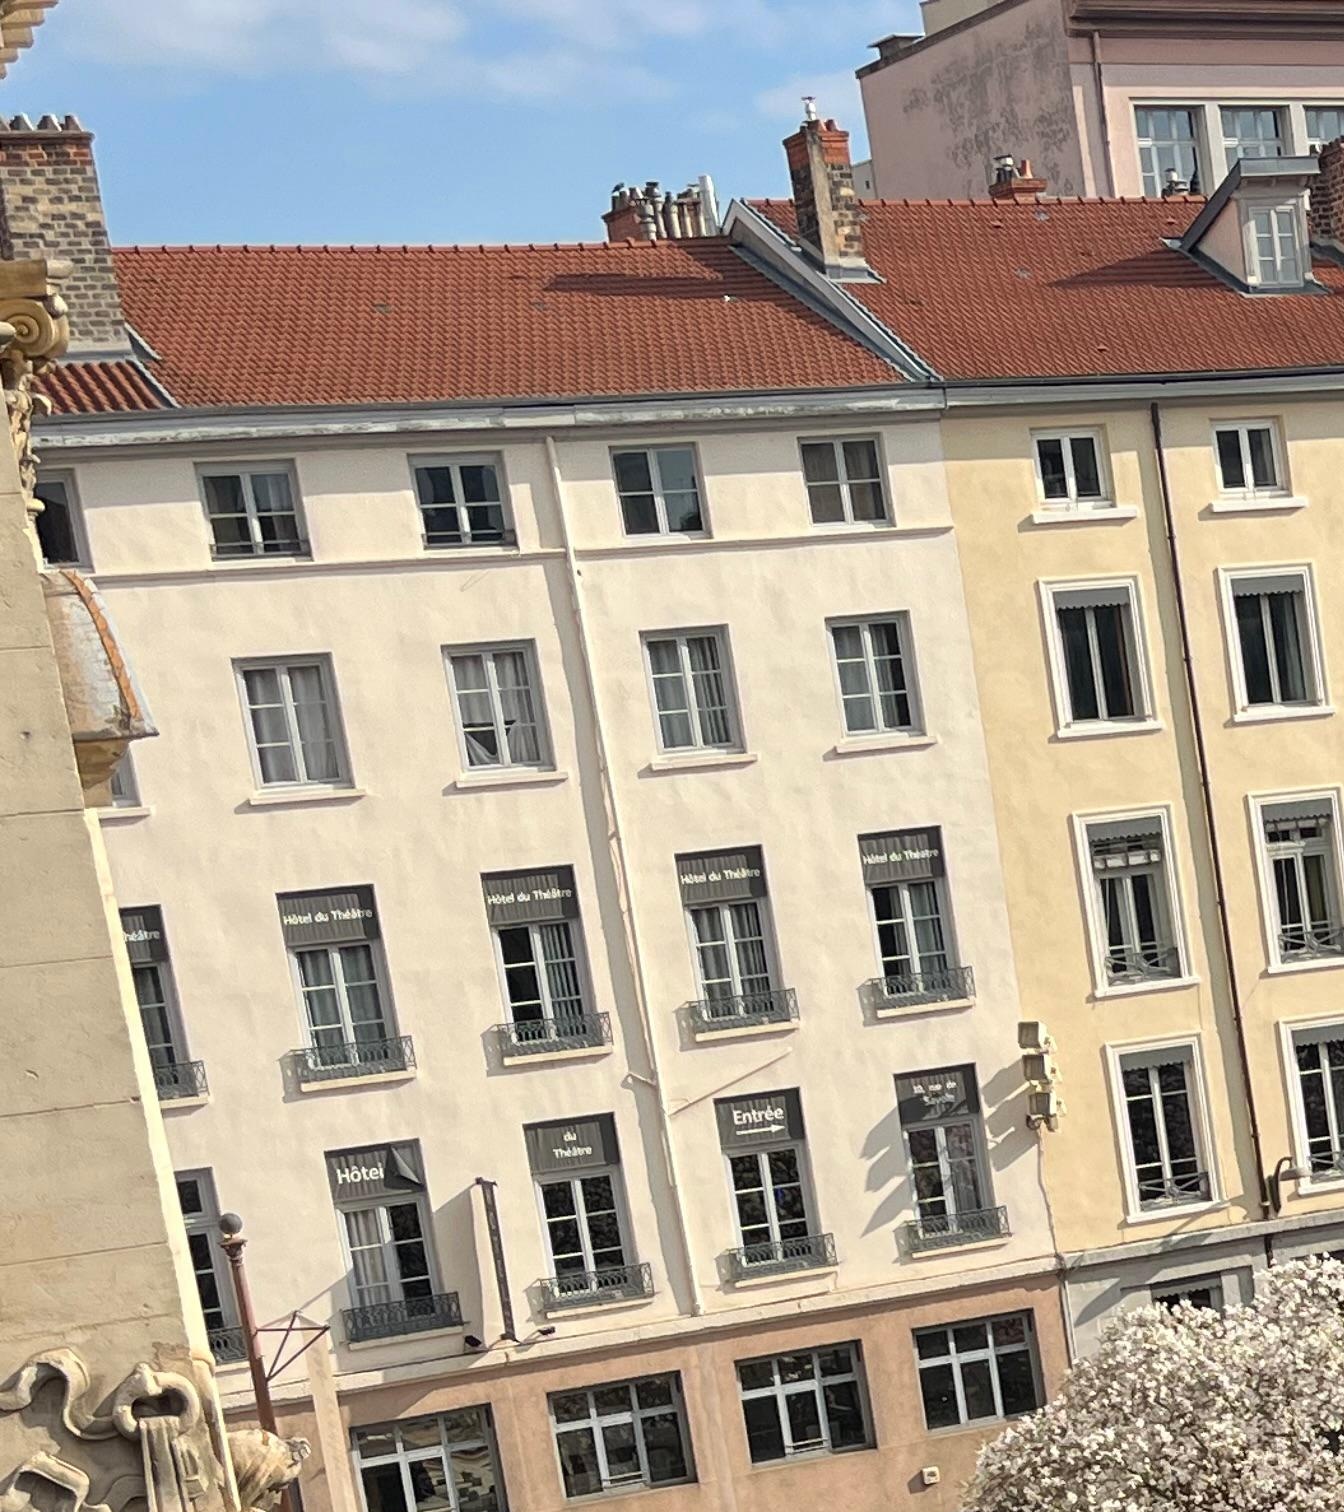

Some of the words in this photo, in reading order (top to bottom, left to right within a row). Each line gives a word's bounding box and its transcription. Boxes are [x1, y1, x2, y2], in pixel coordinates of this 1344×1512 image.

[889, 851, 902, 862] du
[680, 872, 706, 884] Hôtel
[708, 870, 721, 882] du
[723, 868, 760, 880] Théâtre
[486, 892, 514, 904] Hôtel
[516, 891, 530, 902] du
[532, 888, 572, 900] Théâtre
[282, 912, 312, 925] Hôtel
[314, 911, 330, 922] du
[330, 907, 373, 920] Théâtre
[732, 1104, 785, 1126] Entrée
[562, 1130, 577, 1142] du
[552, 1146, 592, 1159] Théâtre
